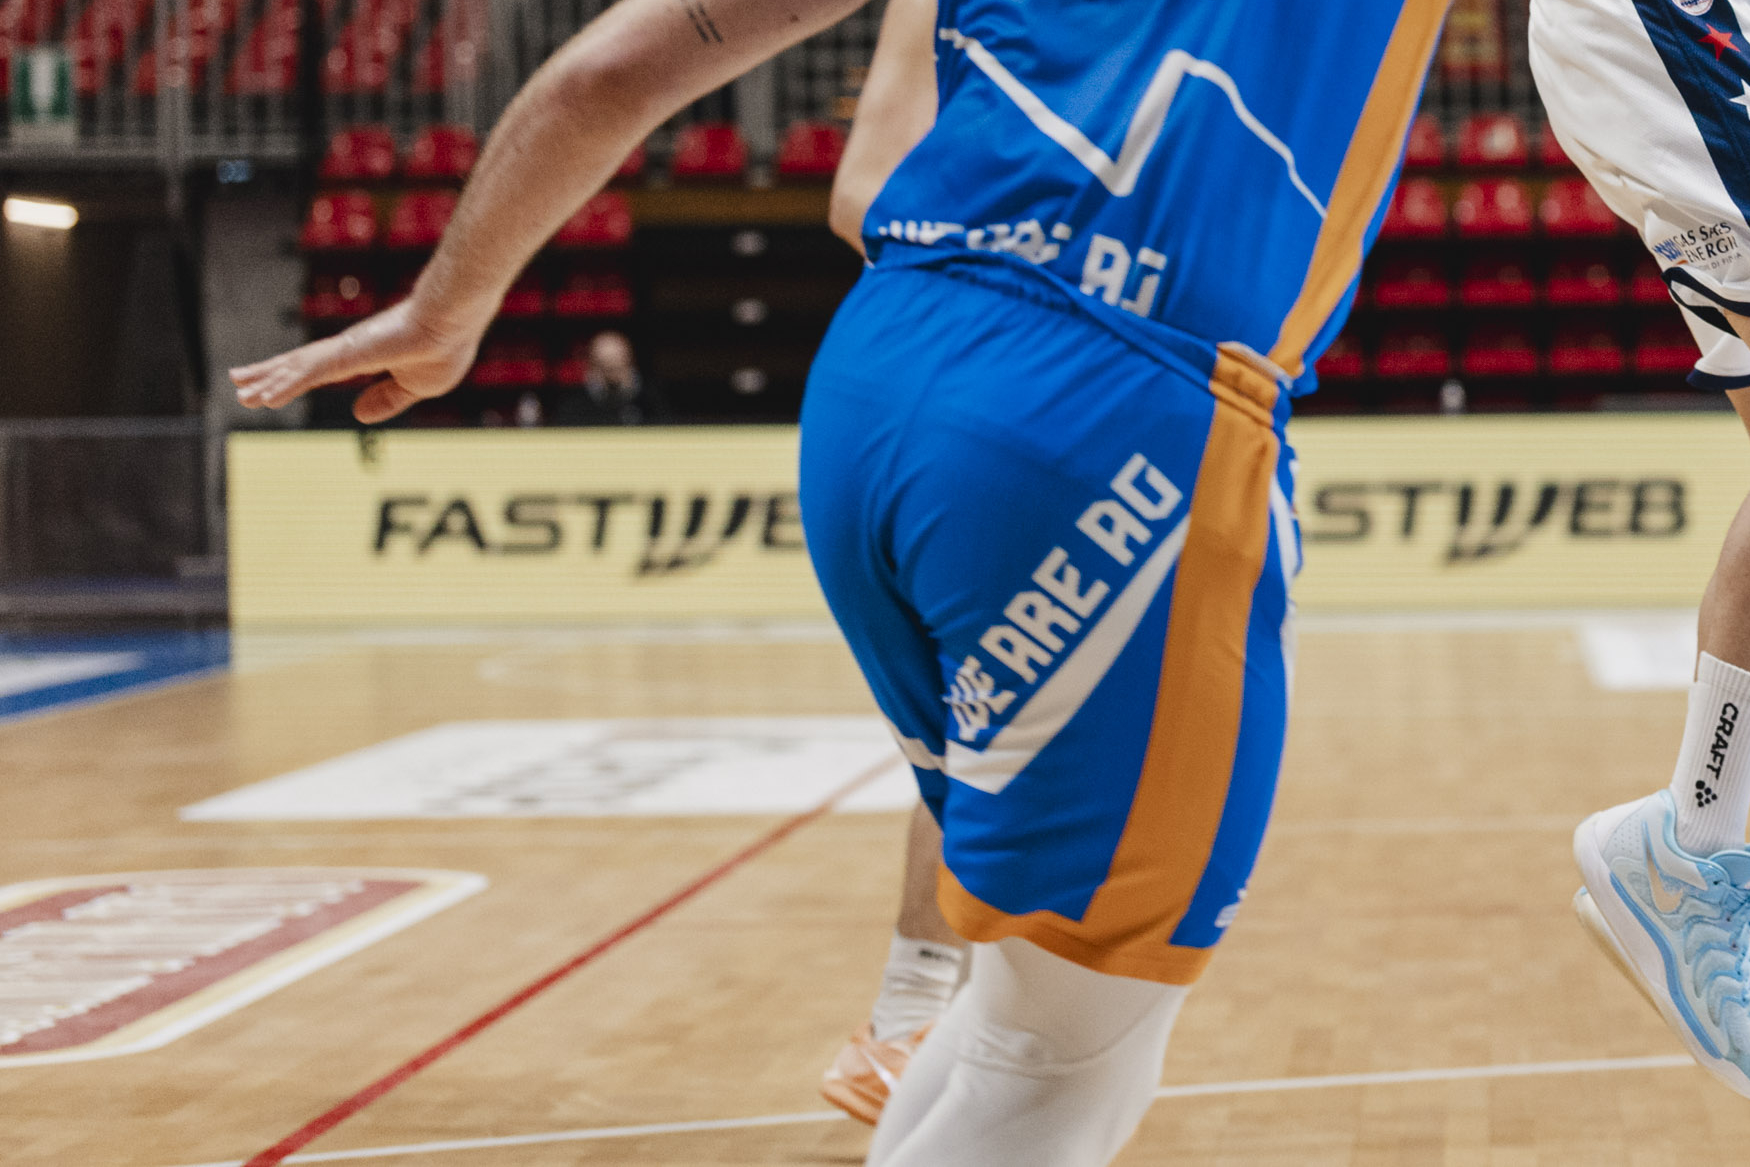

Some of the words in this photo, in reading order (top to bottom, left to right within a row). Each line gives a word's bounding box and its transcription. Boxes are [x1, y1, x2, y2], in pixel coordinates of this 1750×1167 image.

[372, 494, 803, 584] FASTWE
[1302, 478, 1688, 567] STWEB
[979, 545, 1111, 685] ARE
[1074, 451, 1184, 568] AG
[1706, 701, 1740, 781] CRAFT
